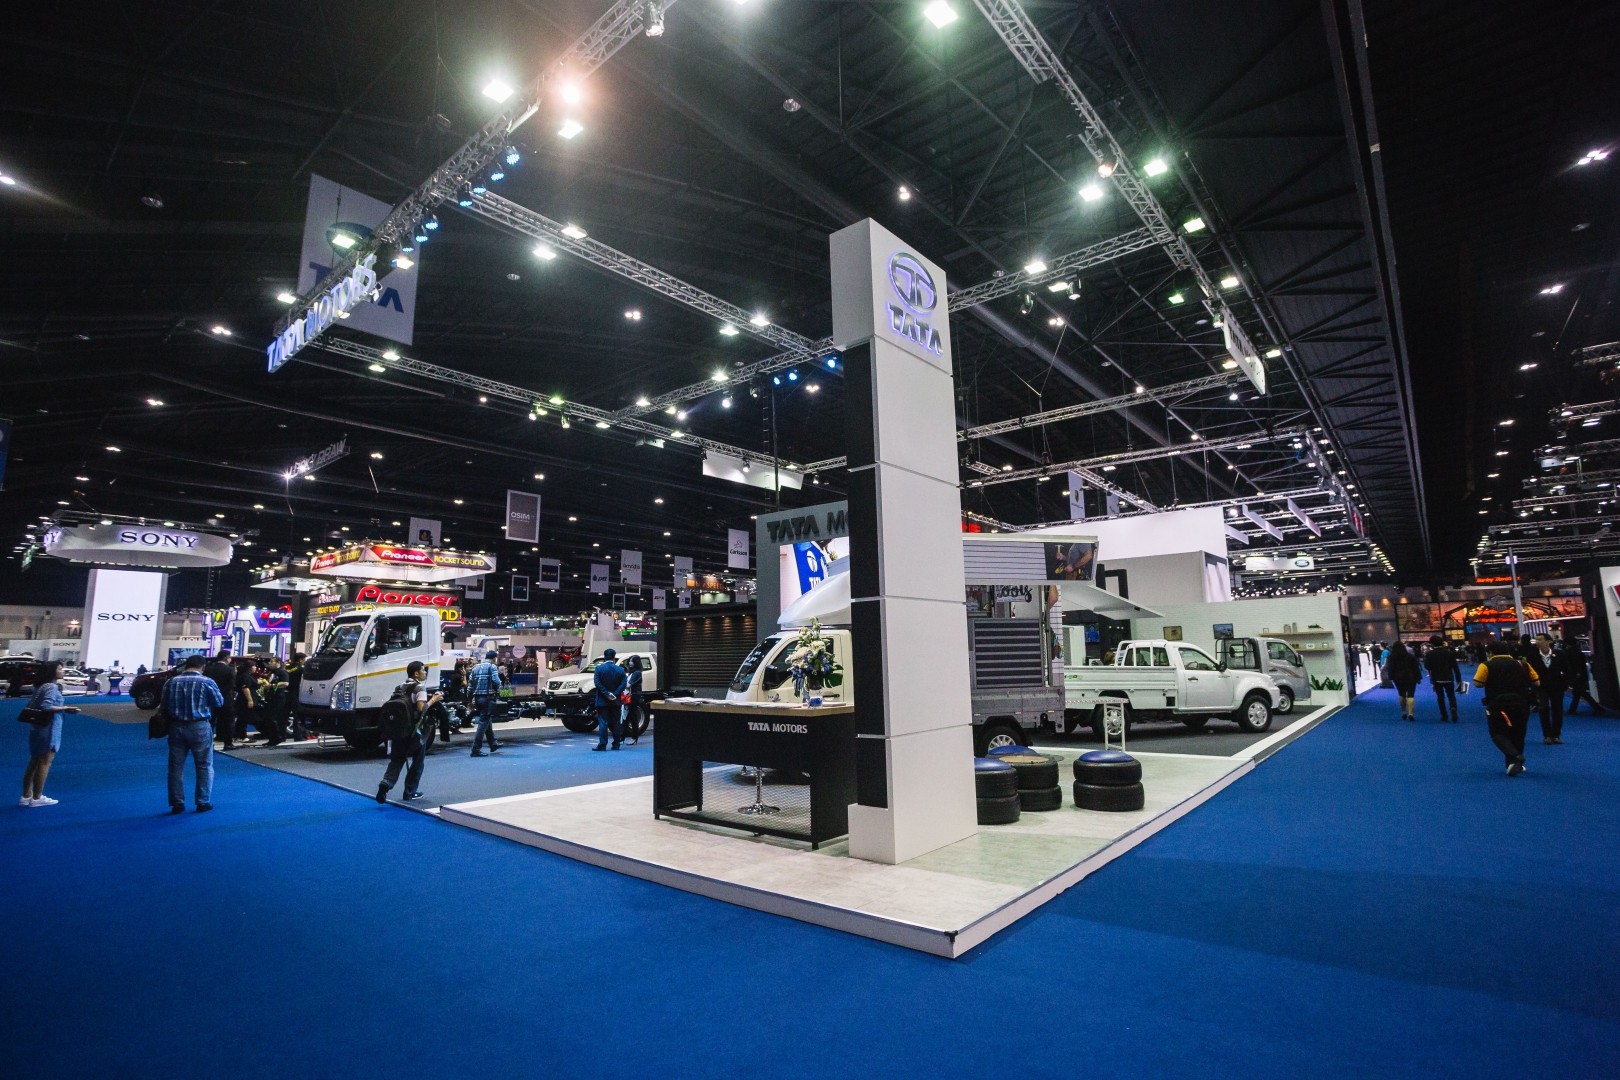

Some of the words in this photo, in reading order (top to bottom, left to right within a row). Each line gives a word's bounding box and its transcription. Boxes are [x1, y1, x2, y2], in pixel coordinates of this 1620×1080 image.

[267, 319, 305, 373] TATA
[305, 253, 377, 340] MOTORS
[888, 302, 943, 356] TATA
[511, 511, 530, 520] OSIM
[767, 515, 820, 542] TATA
[120, 531, 198, 548] SONY
[381, 549, 427, 561] Pioneer
[434, 555, 460, 565] ROCKET
[461, 557, 485, 567] SOUND
[356, 585, 458, 606] Pioneer
[98, 613, 155, 621] SONY
[747, 721, 770, 731] TATA
[772, 723, 808, 733] MOTORS
